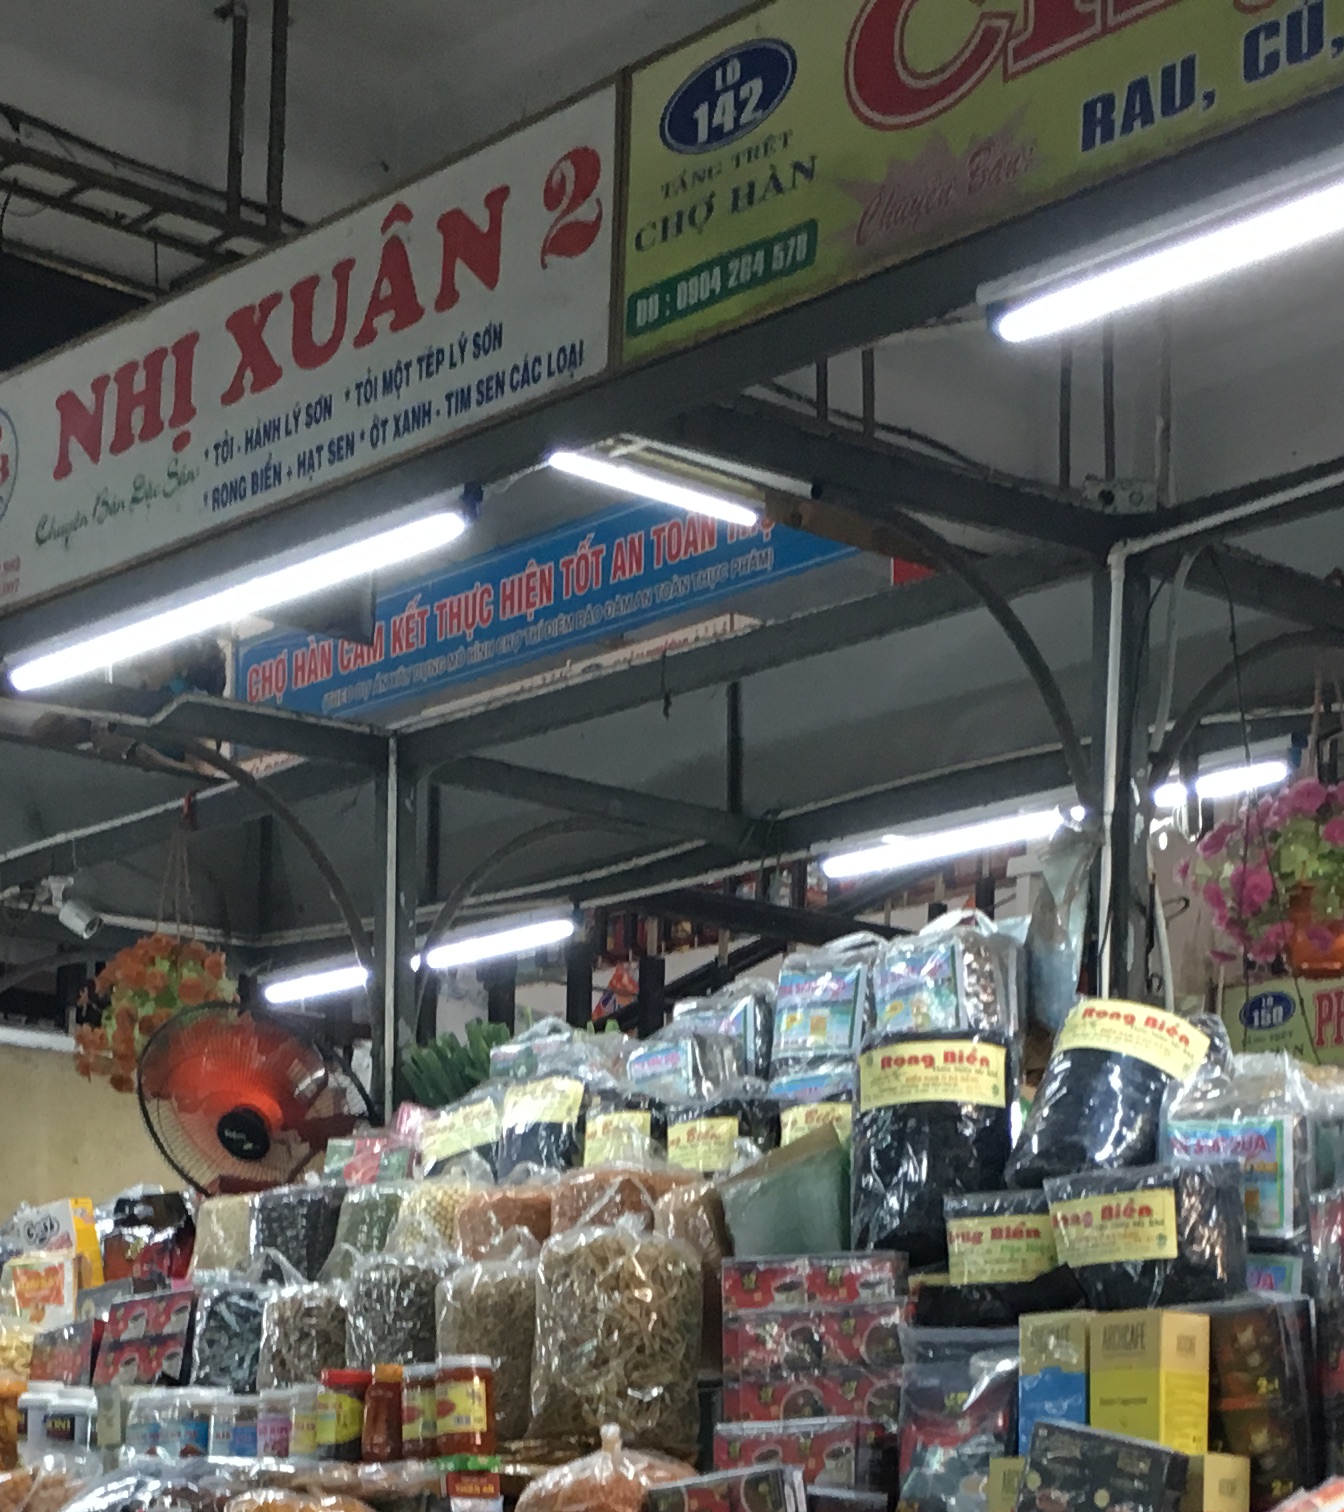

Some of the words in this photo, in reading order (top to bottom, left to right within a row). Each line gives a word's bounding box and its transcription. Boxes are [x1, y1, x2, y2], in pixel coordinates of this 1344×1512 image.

[692, 76, 765, 144] 142
[1079, 54, 1217, 154] RAU,
[634, 190, 717, 252] CHỢ
[731, 153, 819, 214] HÀN
[53, 331, 200, 482] NHỊ
[220, 185, 512, 408] XUÂN
[540, 145, 604, 270] 2
[211, 478, 248, 513] RONG
[297, 443, 324, 482] HẠT
[327, 430, 356, 466] SEN
[368, 413, 388, 451] ỚT
[392, 400, 433, 441] XANH
[444, 383, 473, 420] TIM
[474, 369, 506, 408] SEN
[508, 354, 543, 394] CÁC
[545, 339, 586, 379] LOẠI
[213, 425, 235, 468] TỎI
[284, 402, 302, 438] LÝ
[304, 393, 333, 428] SƠN
[355, 367, 379, 407] TỎI
[382, 359, 414, 401] MỘT
[448, 331, 468, 371] LÝ
[472, 320, 504, 361] SƠN
[247, 647, 289, 704] CHỢ
[293, 634, 334, 690] HÀN
[338, 618, 387, 675] CAM
[390, 592, 432, 658] KẾT
[434, 580, 495, 643] THỰC
[499, 558, 555, 622] HIỆN
[559, 532, 607, 600] TỐT
[609, 528, 646, 584] AN
[880, 1053, 936, 1070] Rong
